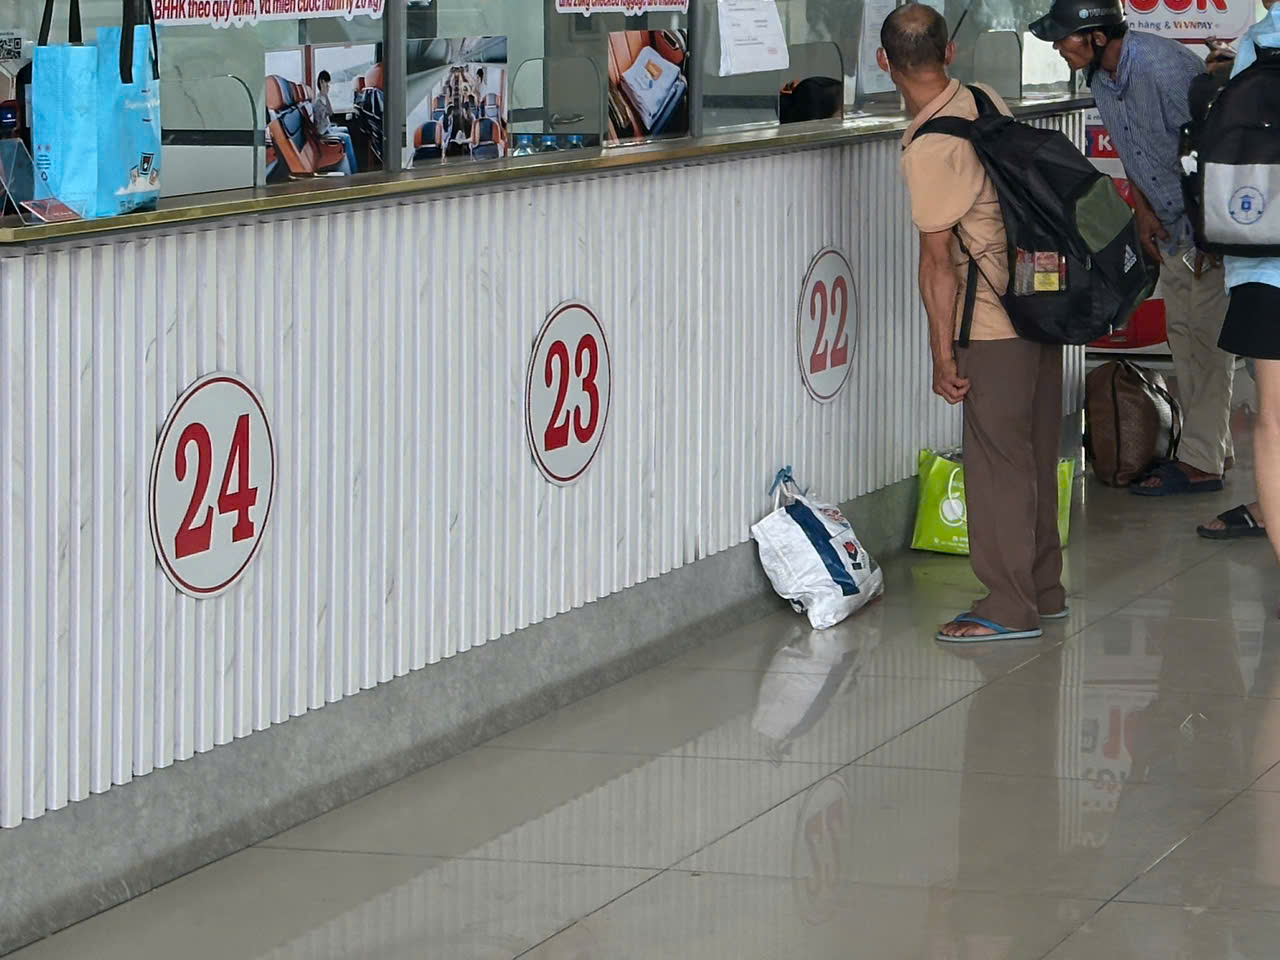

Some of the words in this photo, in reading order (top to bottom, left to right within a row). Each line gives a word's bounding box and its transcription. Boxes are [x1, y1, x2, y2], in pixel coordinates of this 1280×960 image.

[809, 275, 849, 374] 22
[544, 334, 600, 451] 23
[174, 412, 258, 559] 24
